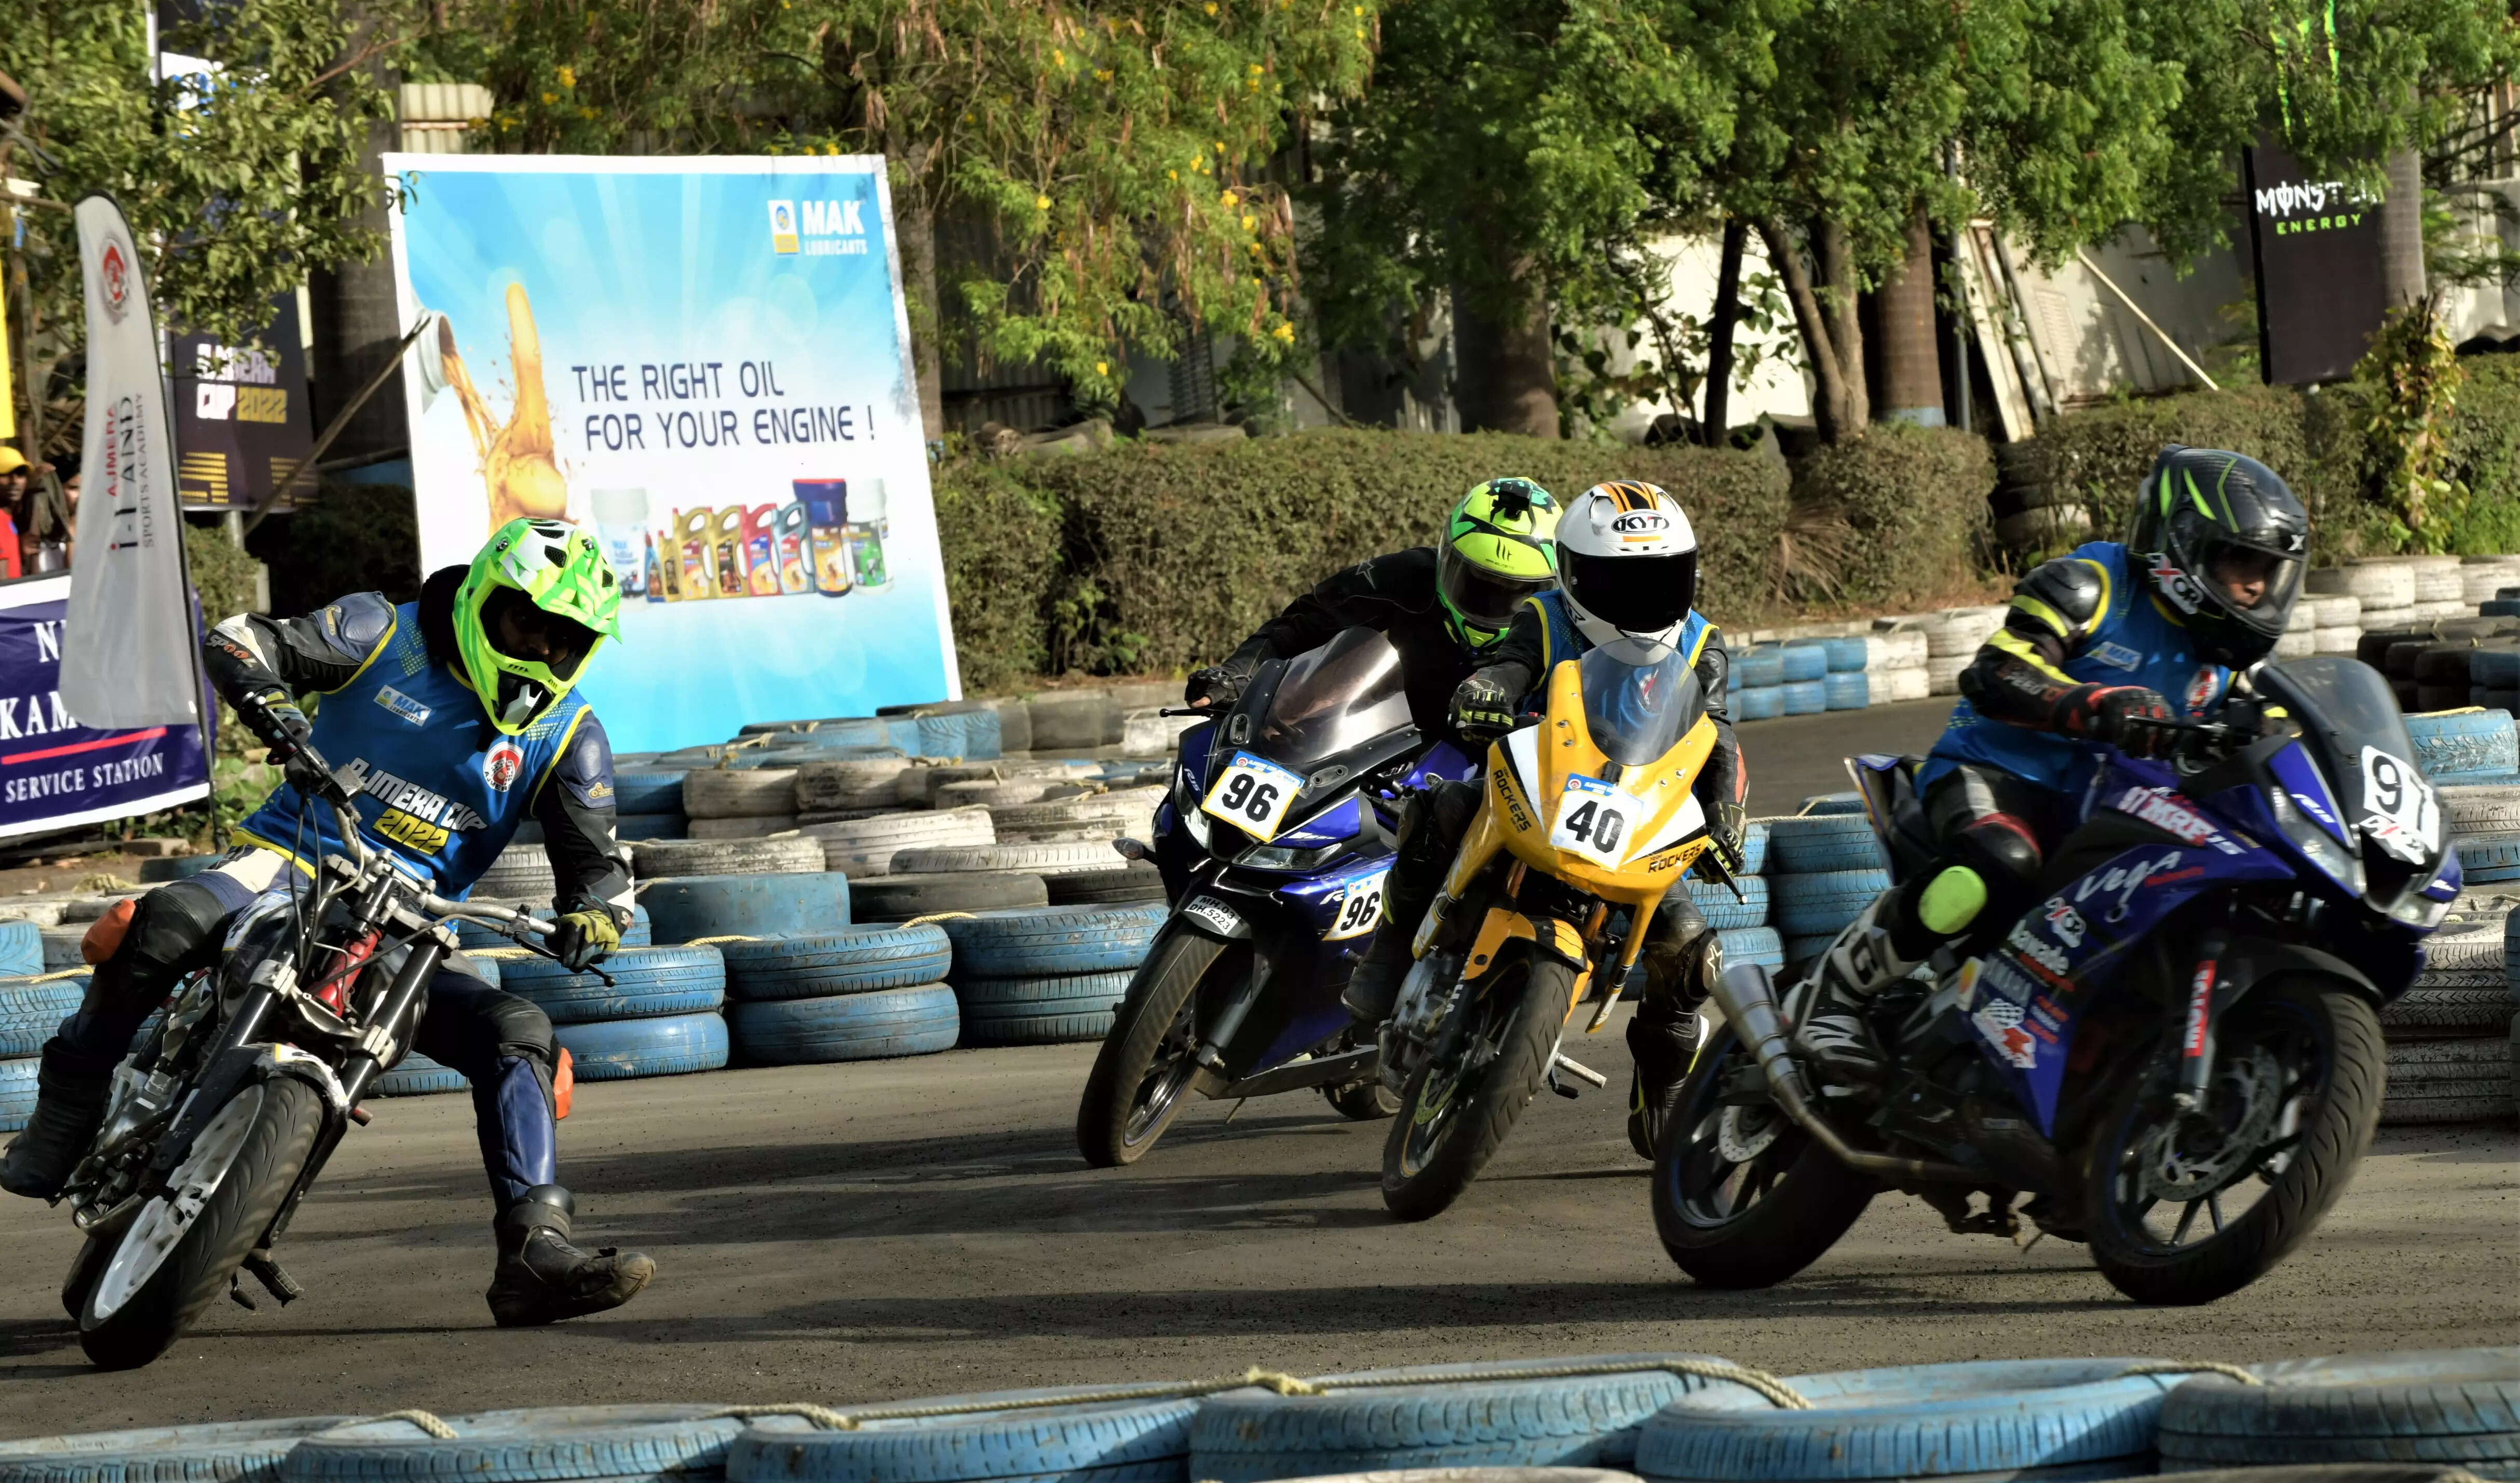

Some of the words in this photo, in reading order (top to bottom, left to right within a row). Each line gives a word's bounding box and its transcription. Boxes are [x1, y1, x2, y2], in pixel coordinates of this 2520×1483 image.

[802, 200, 865, 235] MAK
[2276, 213, 2361, 235] ENERGY
[805, 239, 868, 255] LUBRICANTS
[572, 364, 628, 402] THE
[641, 362, 723, 401] RIGHT
[739, 360, 784, 398] OIL
[236, 386, 287, 424] 2022
[135, 392, 149, 479] ACADEMY
[586, 413, 646, 451] FOR
[655, 410, 740, 449] YOUR
[753, 405, 855, 444] ENGINE
[867, 404, 875, 441] !
[105, 402, 118, 497] AJMERA
[140, 483, 155, 549] SPORTS
[1623, 515, 1665, 530] KYT
[389, 705, 420, 724] LUBRICANTS
[393, 696, 423, 718] MAK
[5, 768, 86, 804] SERVICE
[92, 752, 164, 788] STATION
[349, 757, 449, 822] AJMERA
[440, 801, 488, 832] CUP
[1221, 773, 1279, 823] 96
[1493, 769, 1532, 831] ROCKERS
[372, 808, 450, 855] 2022
[1566, 799, 1625, 854] 40
[1648, 843, 1702, 874] ROCKERS
[1189, 904, 1230, 930] DH.5223
[1199, 896, 1235, 920] MH.03
[1340, 891, 1380, 932] 96
